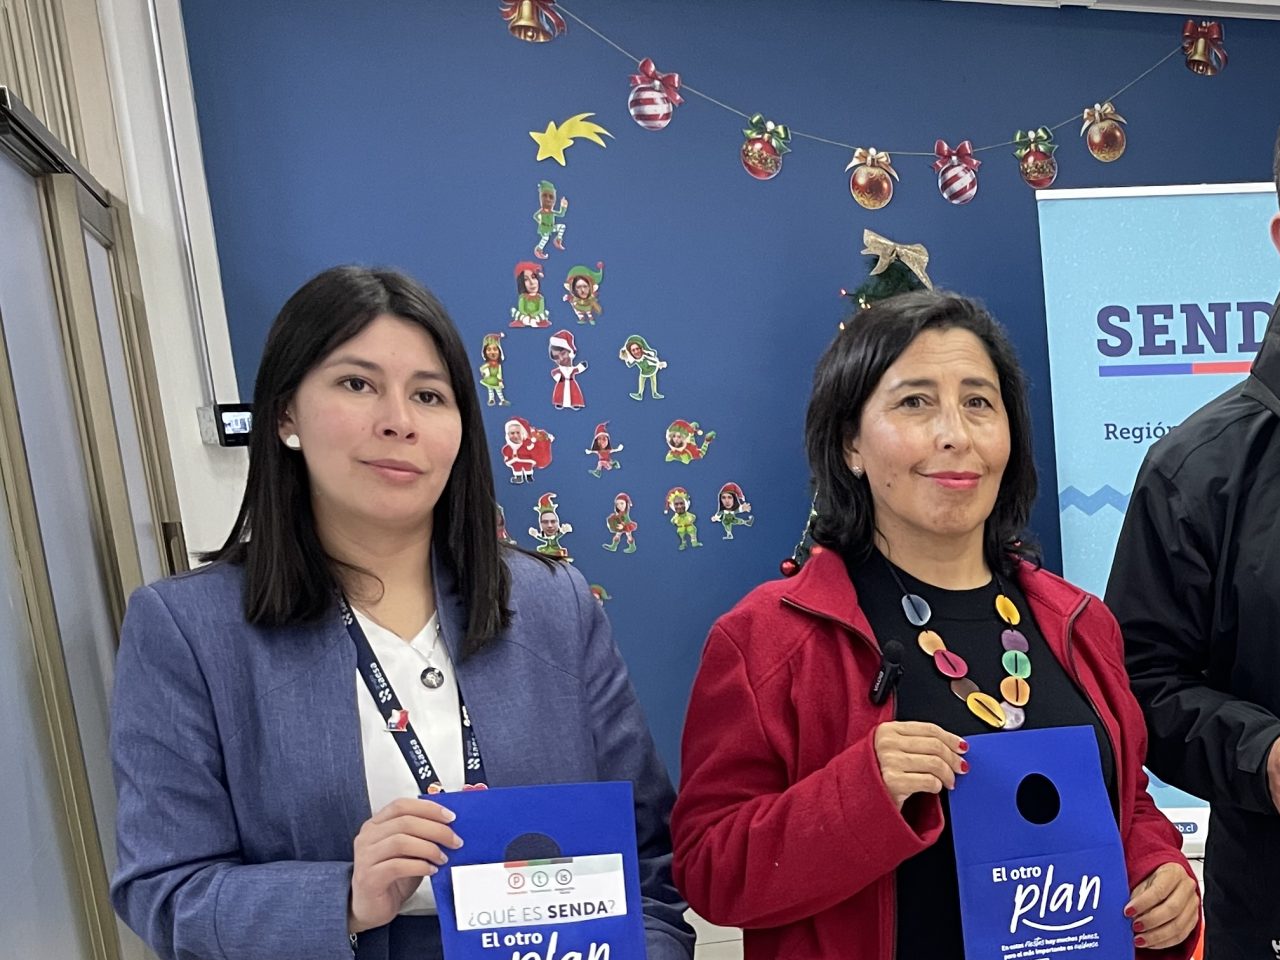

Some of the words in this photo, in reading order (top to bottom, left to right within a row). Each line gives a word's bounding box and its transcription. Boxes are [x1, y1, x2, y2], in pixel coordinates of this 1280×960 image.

[370, 661, 388, 689] saesa
[409, 739, 428, 766] saesa
[992, 866, 1013, 883] El
[1015, 866, 1042, 880] otro
[1010, 863, 1101, 934] plan
[468, 905, 517, 927] ¿QUÉ
[522, 906, 543, 922] ES
[547, 899, 616, 919] SENDA?
[481, 931, 501, 948] El
[503, 931, 543, 947] otro
